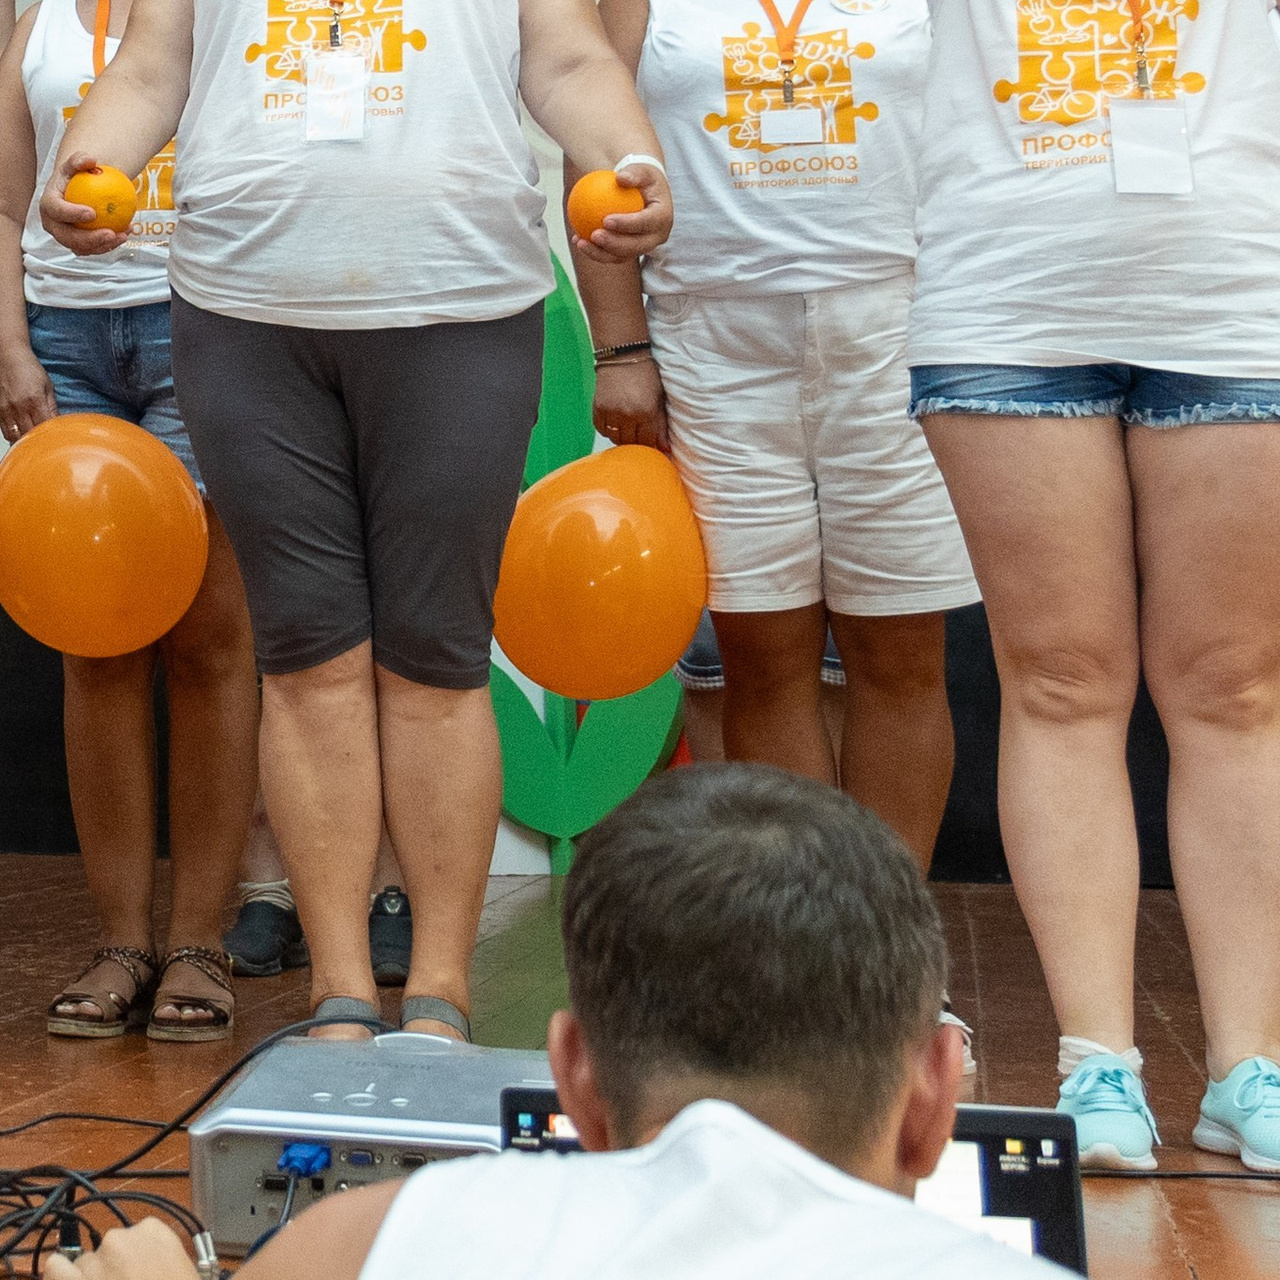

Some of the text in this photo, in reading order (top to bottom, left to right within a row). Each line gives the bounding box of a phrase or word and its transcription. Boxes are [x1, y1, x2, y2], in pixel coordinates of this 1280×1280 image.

[730, 156, 859, 177] ПРОФСОЮЗ
[1024, 154, 1107, 170] ТЕРРИТОРИЯ
[733, 176, 859, 190] ТЕРРИТОРИЯ ЗДОРОВЬЯ
